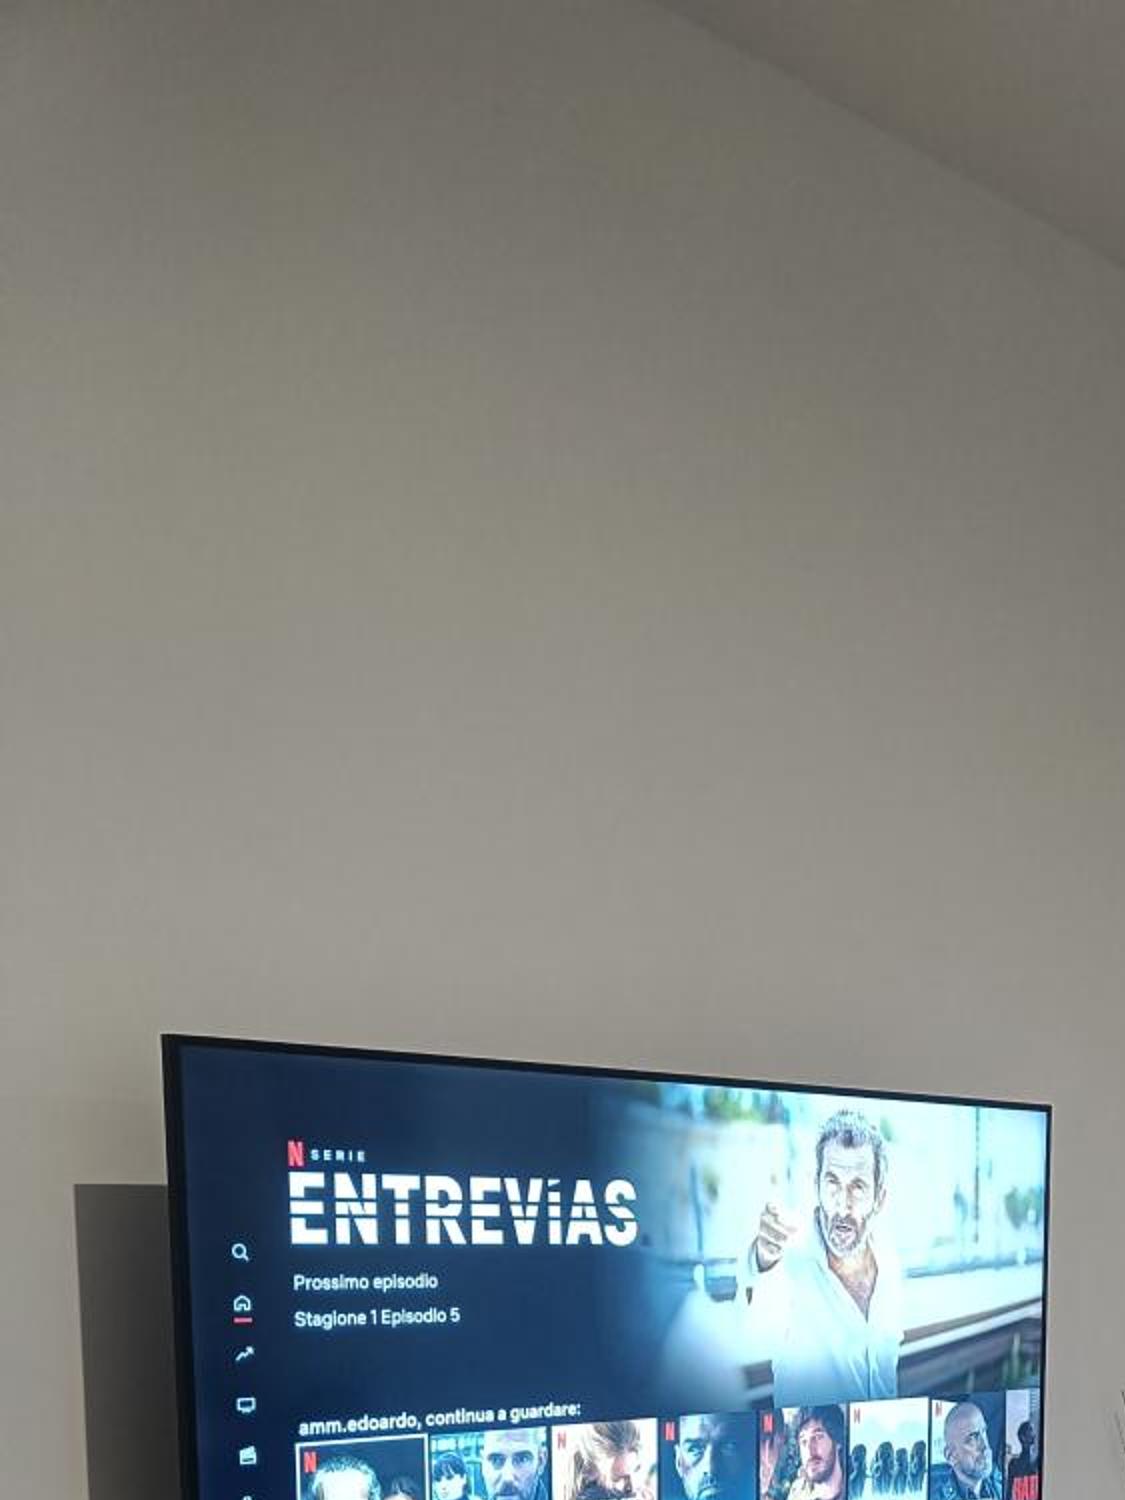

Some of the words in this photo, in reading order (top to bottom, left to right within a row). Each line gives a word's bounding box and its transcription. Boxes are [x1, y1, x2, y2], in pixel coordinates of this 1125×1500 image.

[311, 1149, 366, 1162] SERIE
[293, 1274, 369, 1292] Prossimo
[373, 1273, 438, 1293] episodio
[294, 1311, 366, 1330] Stagione
[370, 1309, 377, 1325] 1
[381, 1309, 446, 1328] Episodio
[450, 1308, 460, 1323] 5
[299, 1412, 422, 1436] amm.edoardo,
[425, 1408, 495, 1427] continua
[497, 1411, 507, 1421] a
[509, 1402, 581, 1423] guardare:
